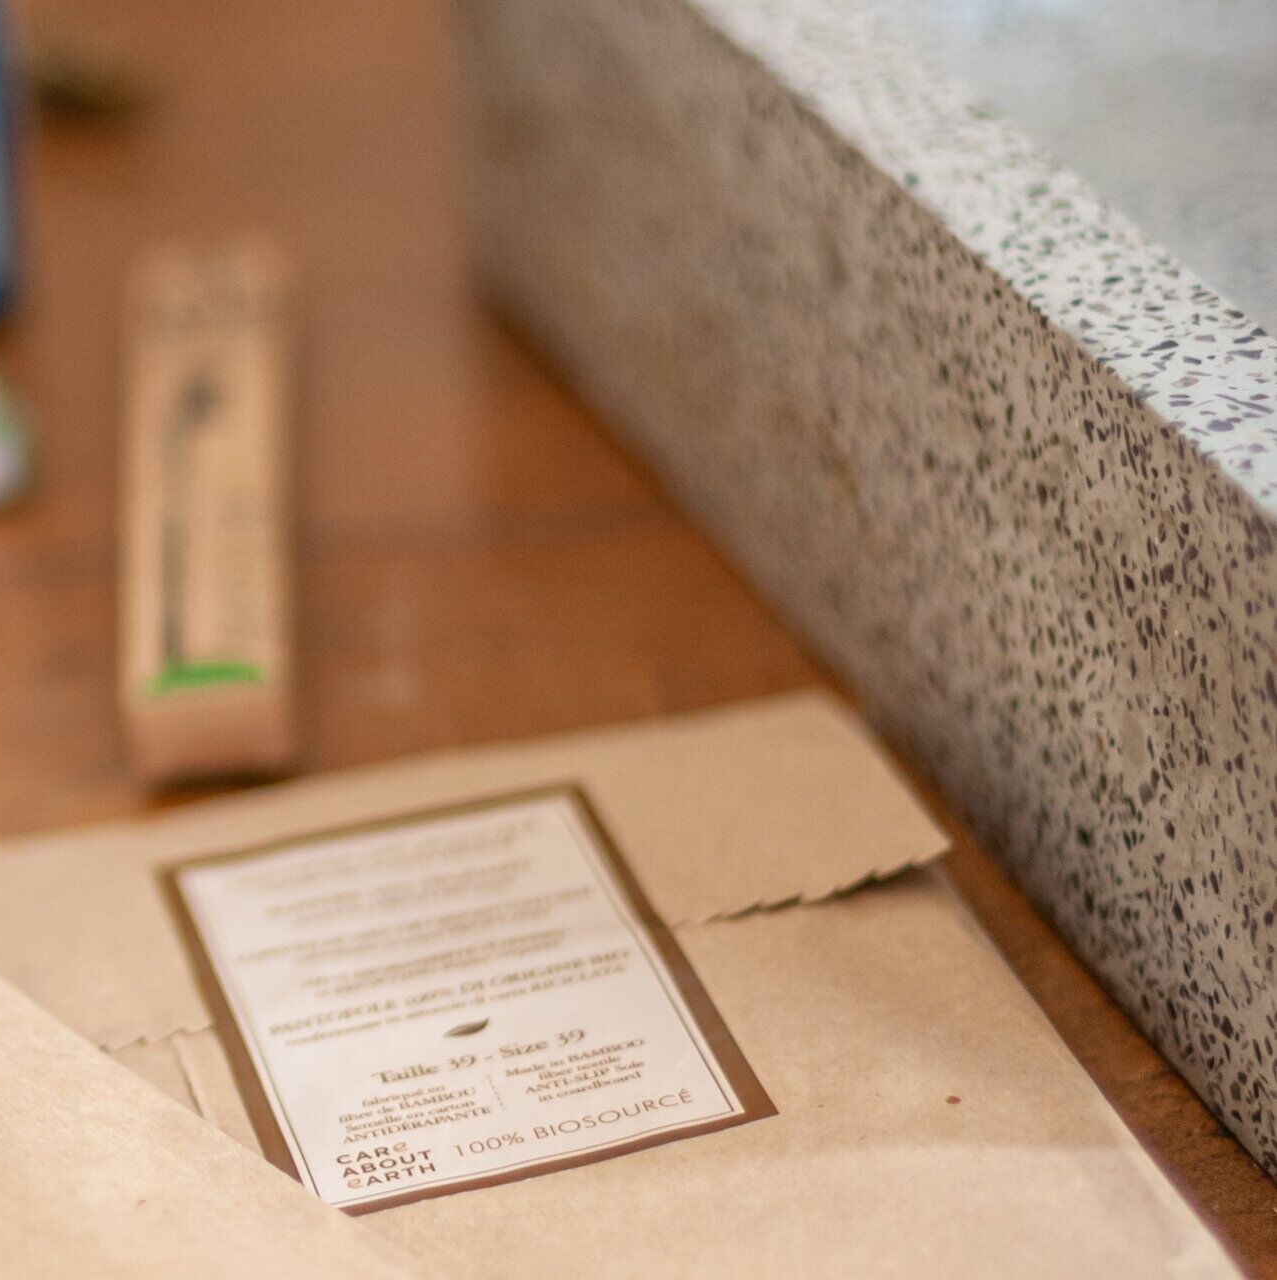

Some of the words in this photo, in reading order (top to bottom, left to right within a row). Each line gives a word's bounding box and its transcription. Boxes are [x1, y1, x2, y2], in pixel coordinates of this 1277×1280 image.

[370, 1063, 439, 1084] Taille
[448, 1053, 477, 1070] 39
[498, 1039, 548, 1059] Size
[557, 1028, 586, 1045] 39
[504, 1062, 546, 1077] Made
[548, 1058, 565, 1068] in
[566, 1038, 645, 1063] BAMBOO
[524, 1066, 610, 1094] ANTI-SLIP
[612, 1060, 645, 1072] Sole
[537, 1066, 573, 1081] fiber
[337, 1110, 373, 1124] fibre
[375, 1104, 395, 1115] de
[397, 1086, 476, 1110] BAMBOU
[360, 1086, 424, 1108] fabriqué
[426, 1084, 446, 1094] en
[537, 1093, 554, 1103] in
[342, 1105, 491, 1144] ANTIDÉRAPANTE
[344, 1113, 403, 1133] Semelle
[404, 1110, 425, 1120] en
[426, 1099, 476, 1116] carton
[453, 1130, 525, 1157] 100%
[531, 1087, 693, 1140] BIOSOURCÉ
[341, 1148, 431, 1178] ABOUT
